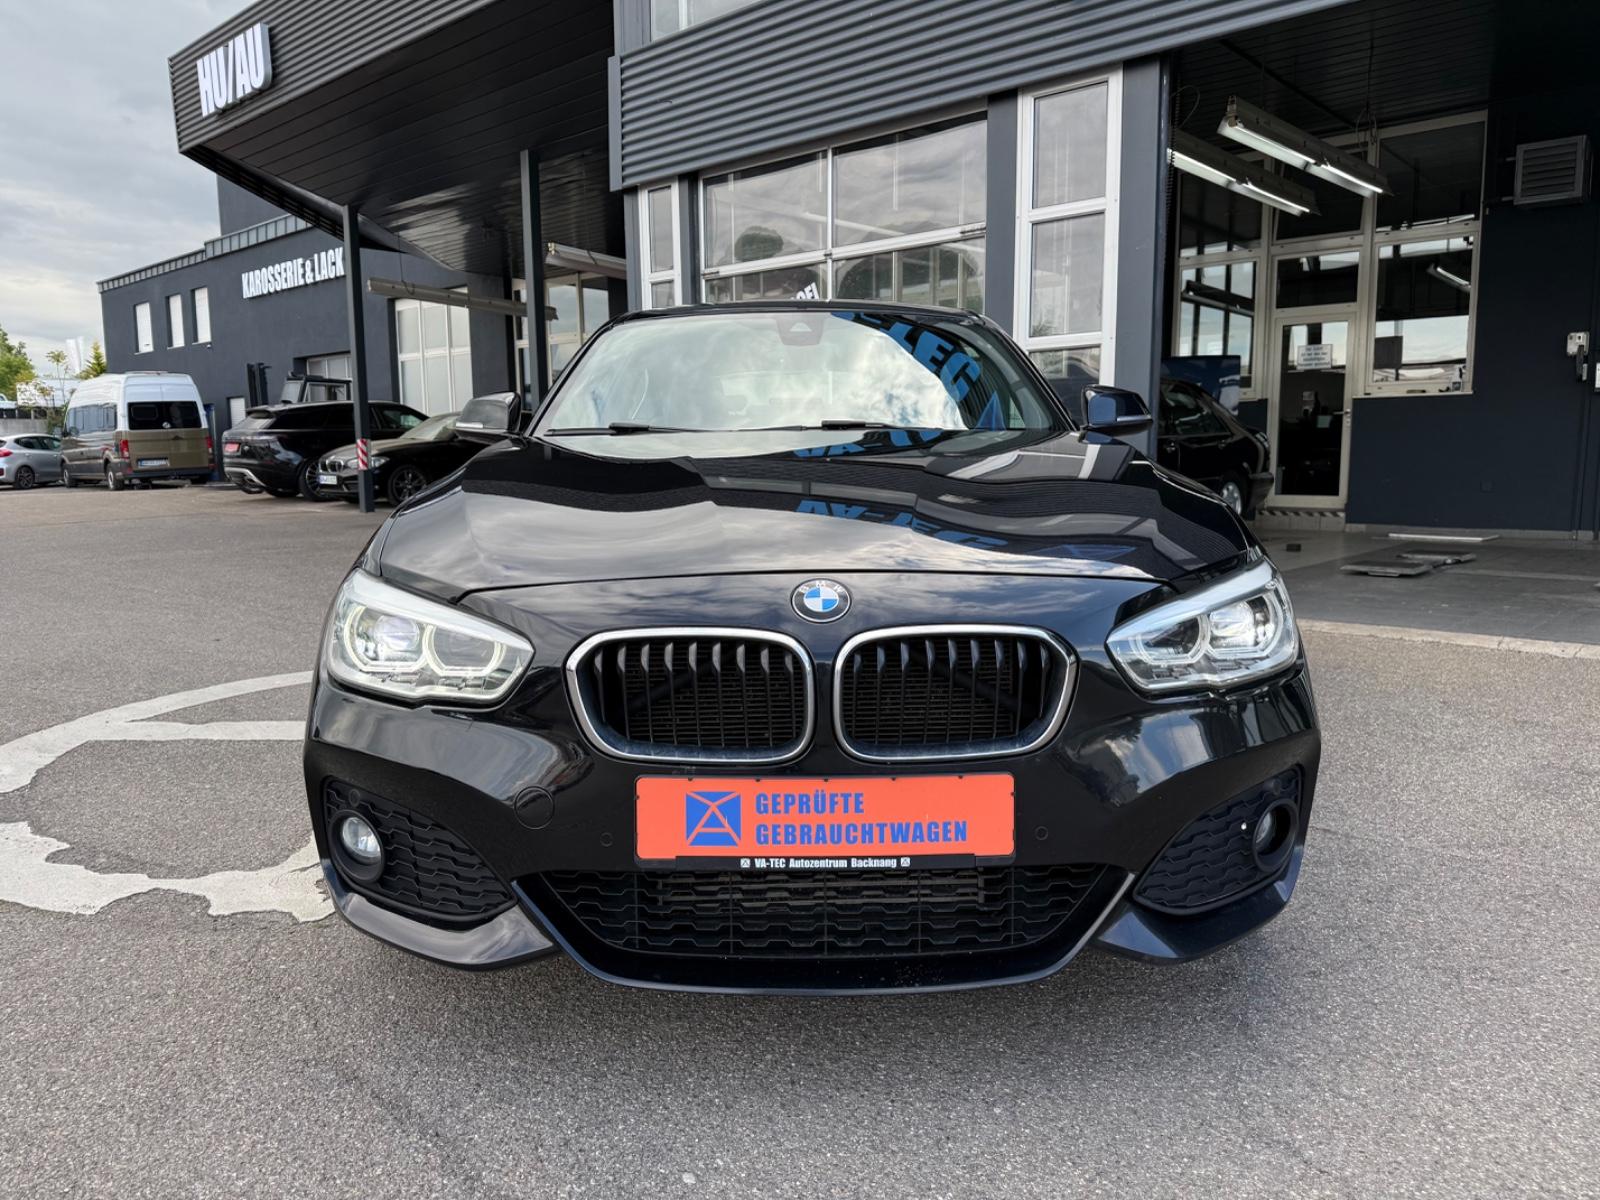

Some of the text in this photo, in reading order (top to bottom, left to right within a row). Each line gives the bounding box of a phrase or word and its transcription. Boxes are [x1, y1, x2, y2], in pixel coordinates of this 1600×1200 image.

[196, 22, 268, 117] HU/AU
[241, 247, 345, 299] KAROSSERIE & LACK
[755, 790, 864, 815] GEPRÜFTE
[755, 820, 967, 845] GEBRAUCHTWAGEN
[754, 857, 897, 869] VA-TEC Autozentrum Backnang
